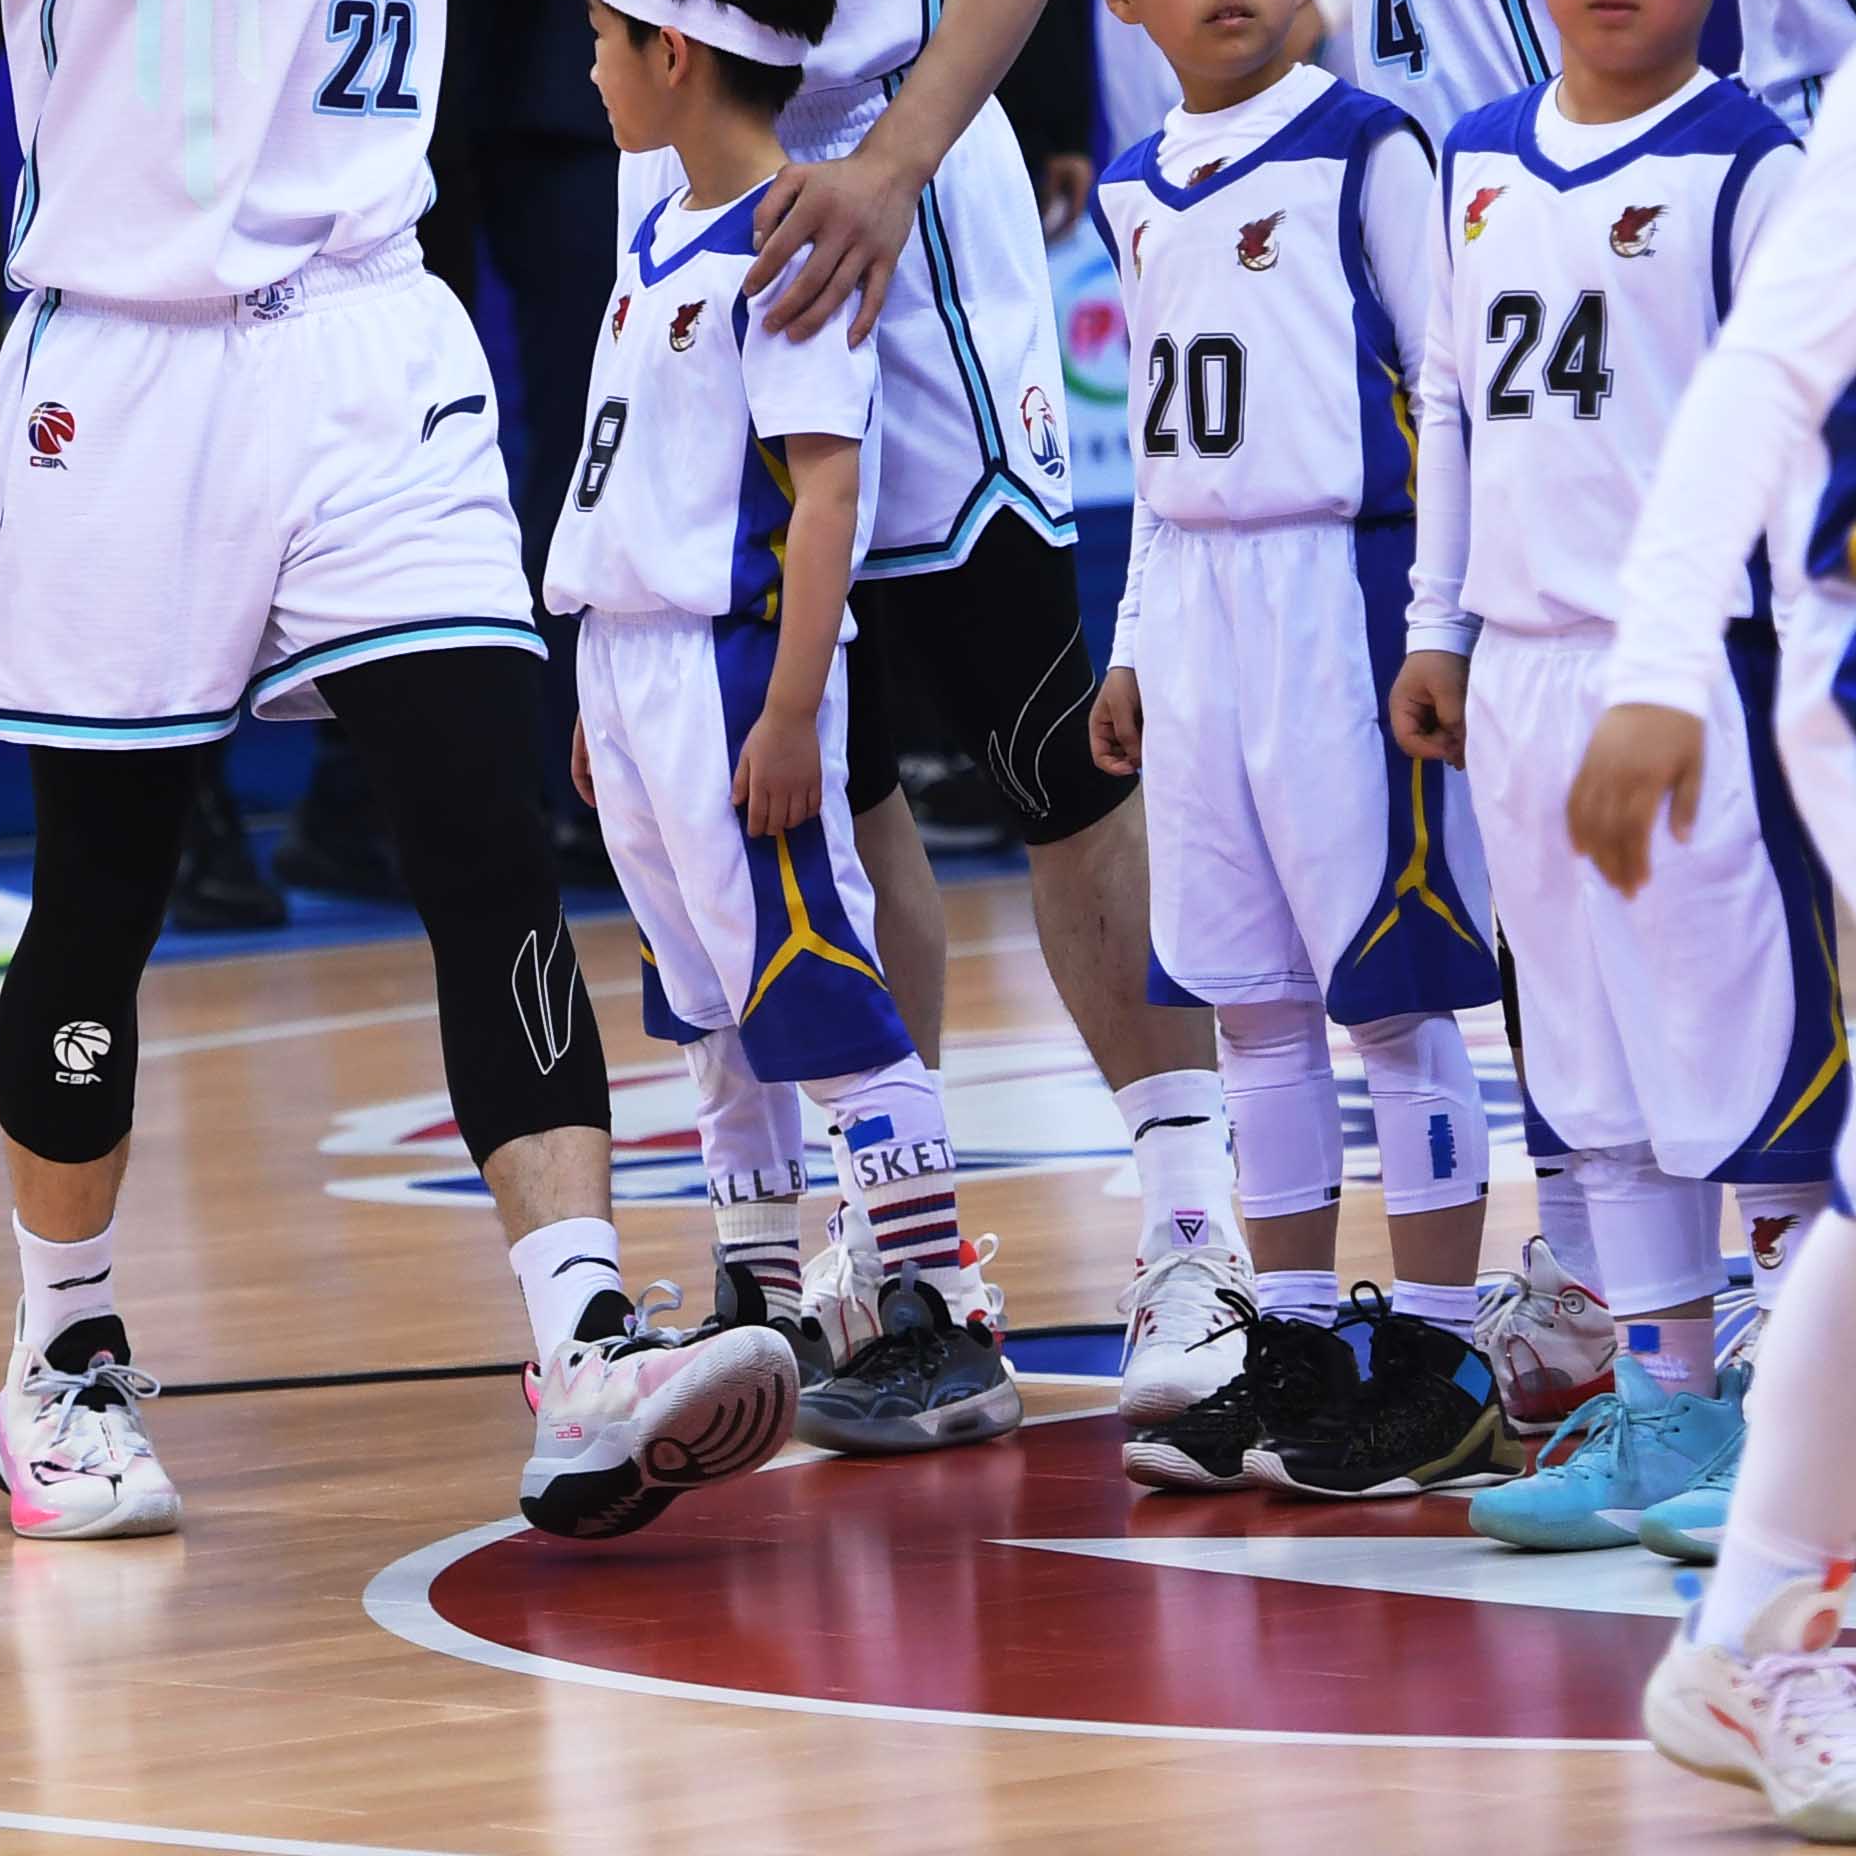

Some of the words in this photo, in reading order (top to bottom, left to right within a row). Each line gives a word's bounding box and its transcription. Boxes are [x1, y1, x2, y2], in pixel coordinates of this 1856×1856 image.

[1485, 290, 1614, 422] 24
[1144, 332, 1247, 459] 20
[30, 455, 69, 471] CBA
[55, 1071, 102, 1085] CBA
